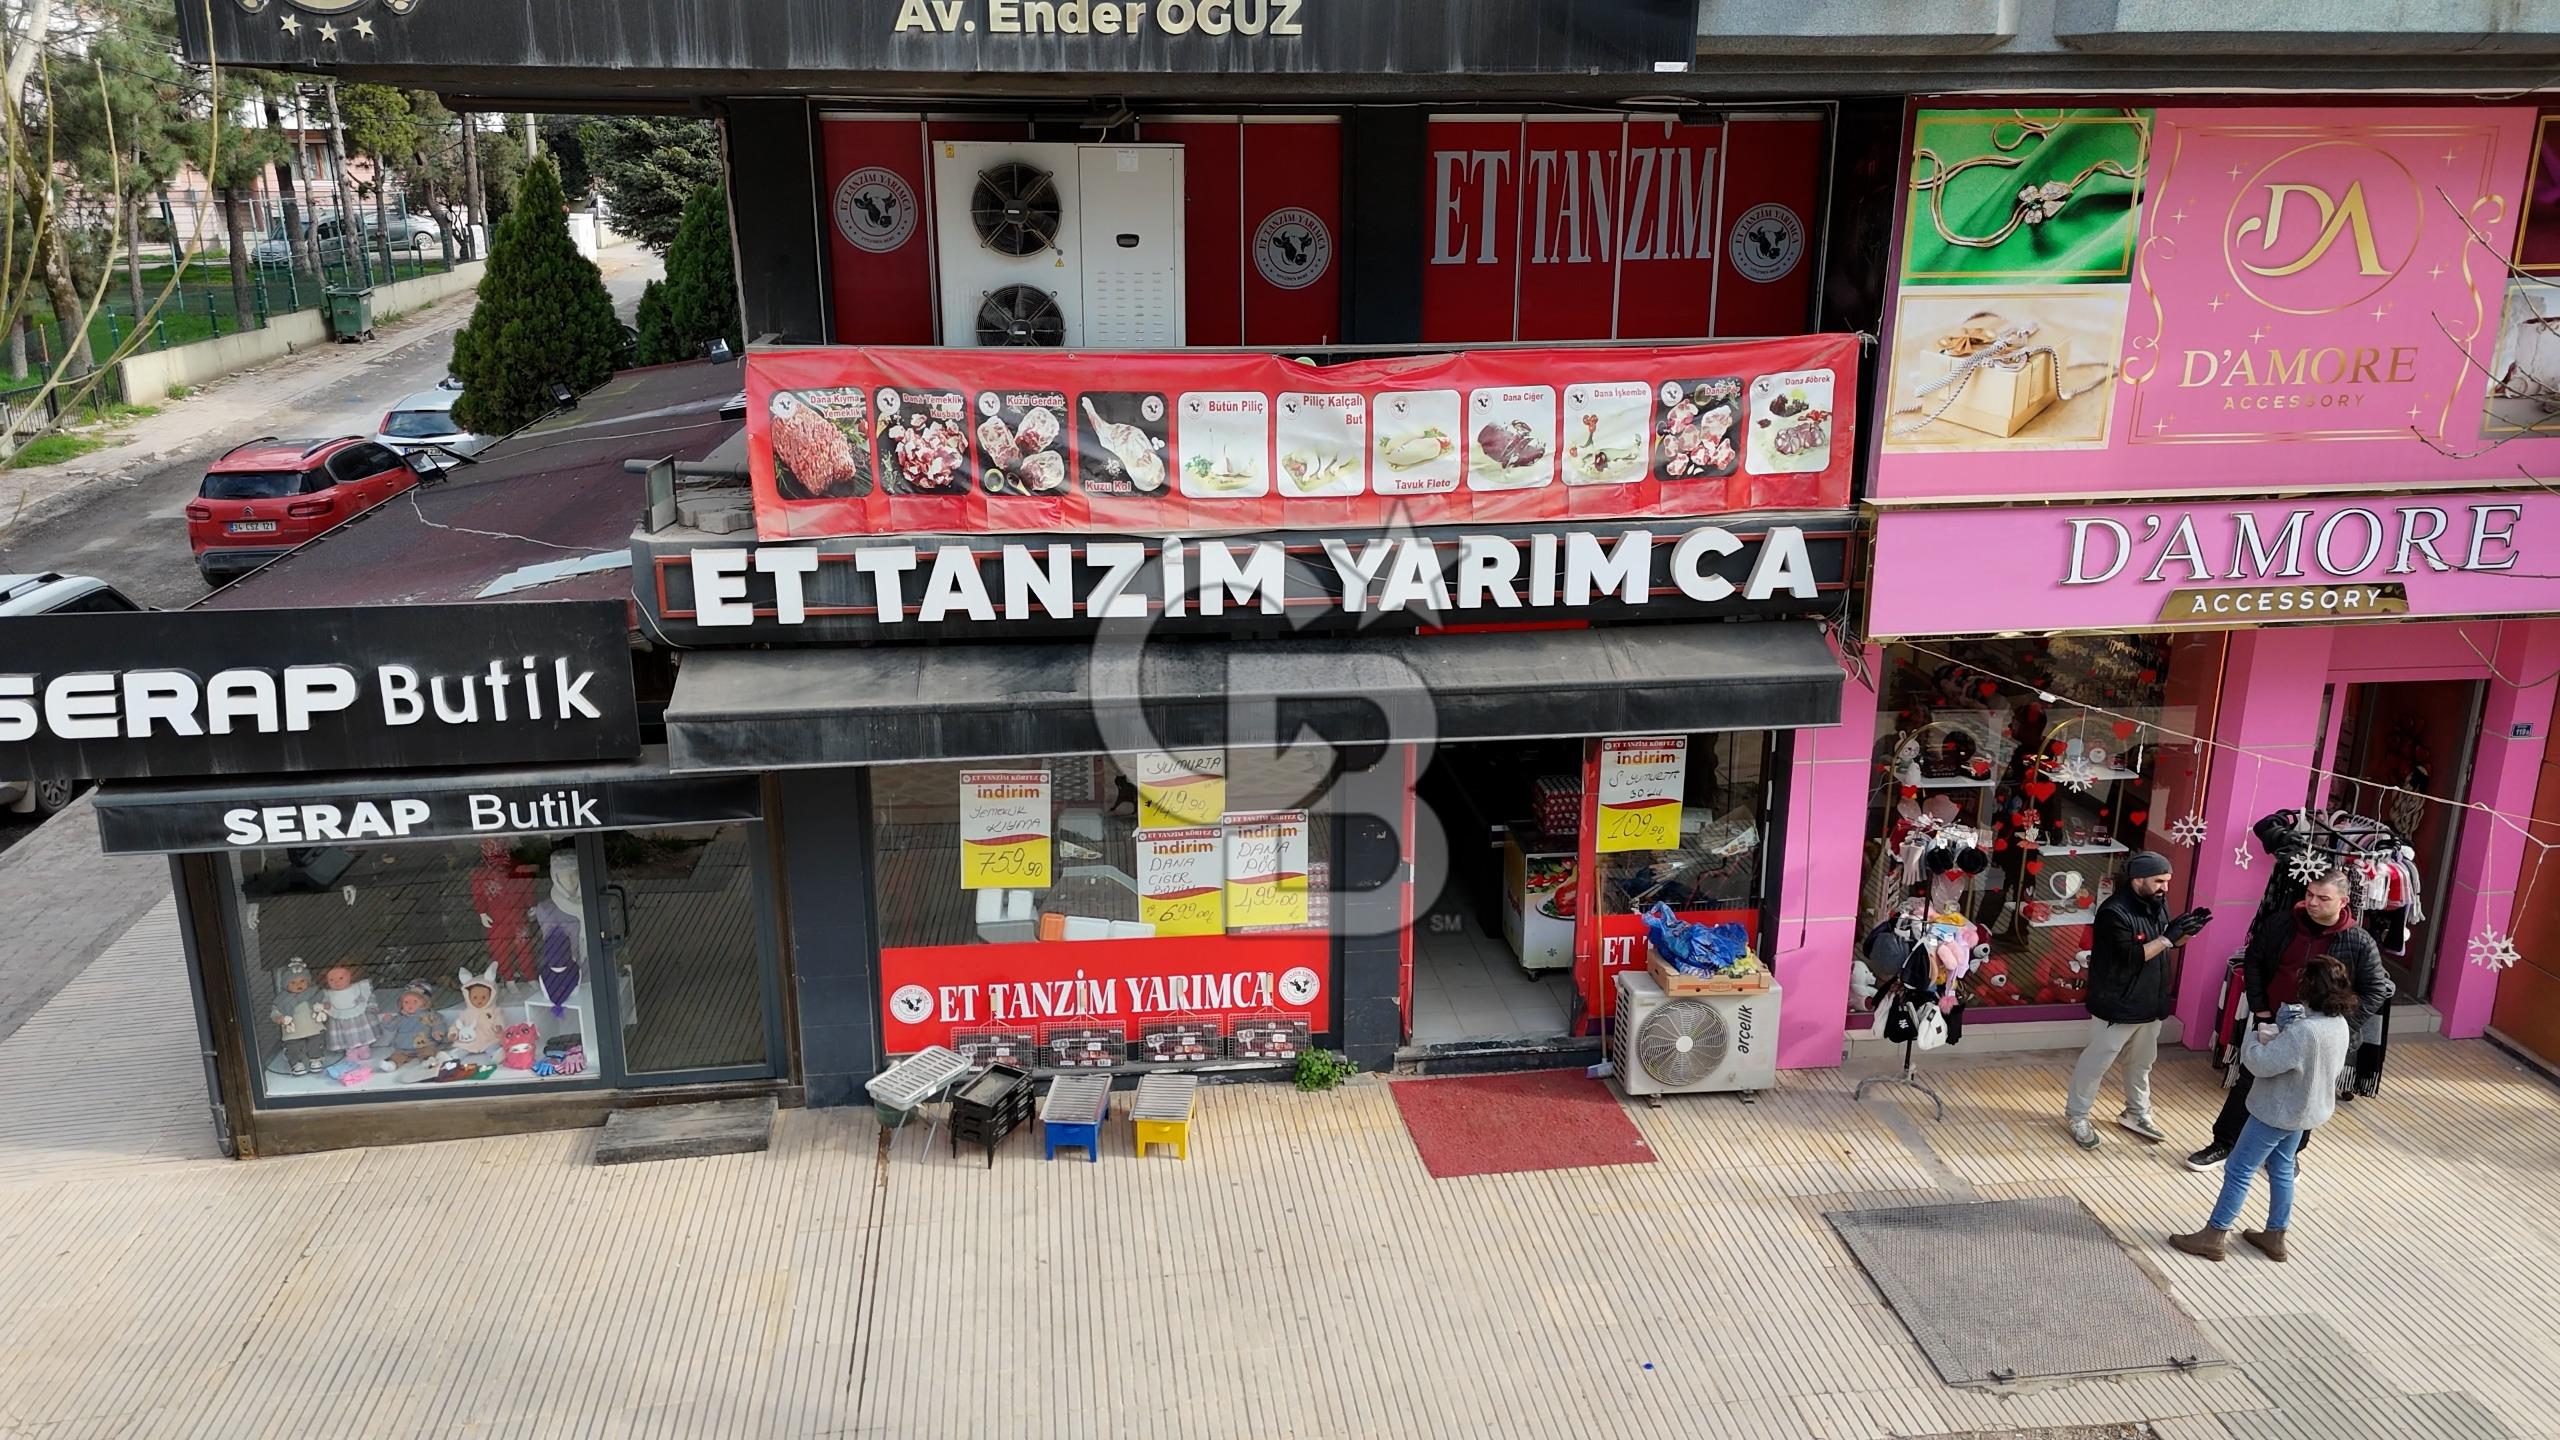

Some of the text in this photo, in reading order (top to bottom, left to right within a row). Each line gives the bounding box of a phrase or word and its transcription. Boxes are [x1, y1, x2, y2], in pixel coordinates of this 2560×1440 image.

[894, 0, 976, 32] Av.
[989, 0, 1146, 33] Ender
[1430, 119, 1718, 265] ET TANZİM
[810, 394, 860, 405] Dana Kıyma
[903, 393, 963, 404] Dana Yemeklik
[1006, 395, 1064, 406] Kuzu Gerdan
[1594, 389, 1613, 398] Dana
[1209, 400, 1263, 414] Bütün Piliç
[1303, 395, 1363, 410] Piliç Kalçalı
[2223, 393, 2365, 410] ACCESSORY
[823, 409, 862, 418] Yemeklik
[1346, 414, 1363, 424] But
[1085, 480, 1131, 492] Kuzu Kol
[1395, 479, 1424, 490] Tavuk
[262, 521, 273, 530] 121
[690, 547, 819, 627] ET
[855, 534, 1285, 623] TANZİM
[2191, 588, 2382, 614] ACCESSORY
[377, 656, 601, 728] Butik
[1616, 751, 1675, 764] indirim
[977, 784, 1040, 798] indirim
[223, 790, 601, 845] SERAP Butik
[1238, 824, 1297, 838] indirim
[1153, 840, 1213, 854] indirim
[1236, 841, 1290, 859] DANA
[1150, 857, 1195, 872] DANA
[1602, 936, 1635, 966] ET
[938, 984, 979, 1022] ET
[988, 968, 1117, 1020] TANZİM
[1125, 971, 1274, 1013] YARIMCA
[1737, 1004, 1753, 1054] arçelik
